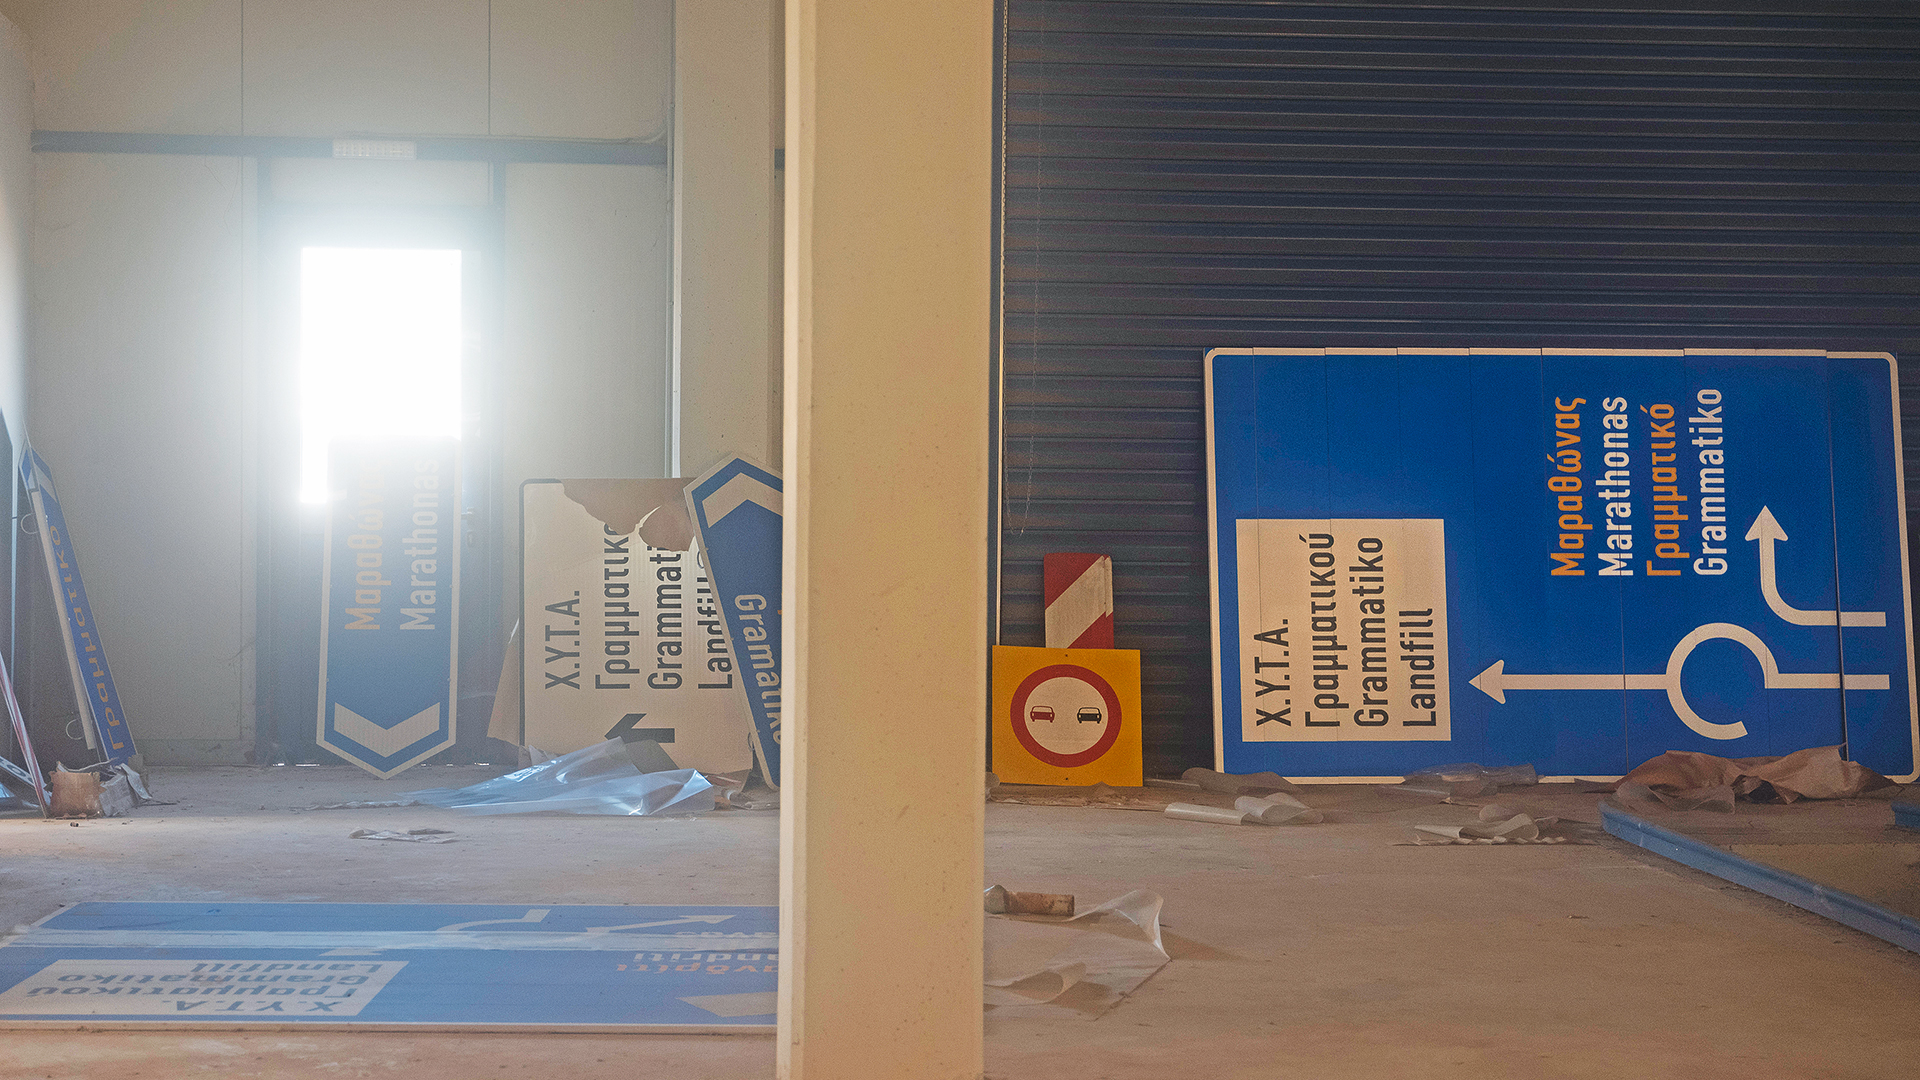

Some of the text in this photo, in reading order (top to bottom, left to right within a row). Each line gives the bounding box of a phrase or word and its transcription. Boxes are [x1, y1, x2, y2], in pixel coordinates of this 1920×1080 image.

[400, 459, 439, 630] Marathonas
[1547, 397, 1593, 576] Μαραθώνας
[1596, 397, 1634, 576] Marathonas
[1640, 404, 1690, 576] Γραμματικό
[1689, 389, 1728, 575] Grammatiko
[545, 590, 581, 690] Χ.Υ.Τ.Α.
[1253, 619, 1291, 727] Χ.Υ.Τ.Α.
[1299, 533, 1349, 728] Γραμματικού
[1349, 537, 1389, 727] Grammatiko
[1399, 608, 1437, 727] Landfill
[26, 986, 358, 998] Γραμματικού
[57, 975, 370, 986] Grammatiko
[189, 963, 383, 973] Landfill
